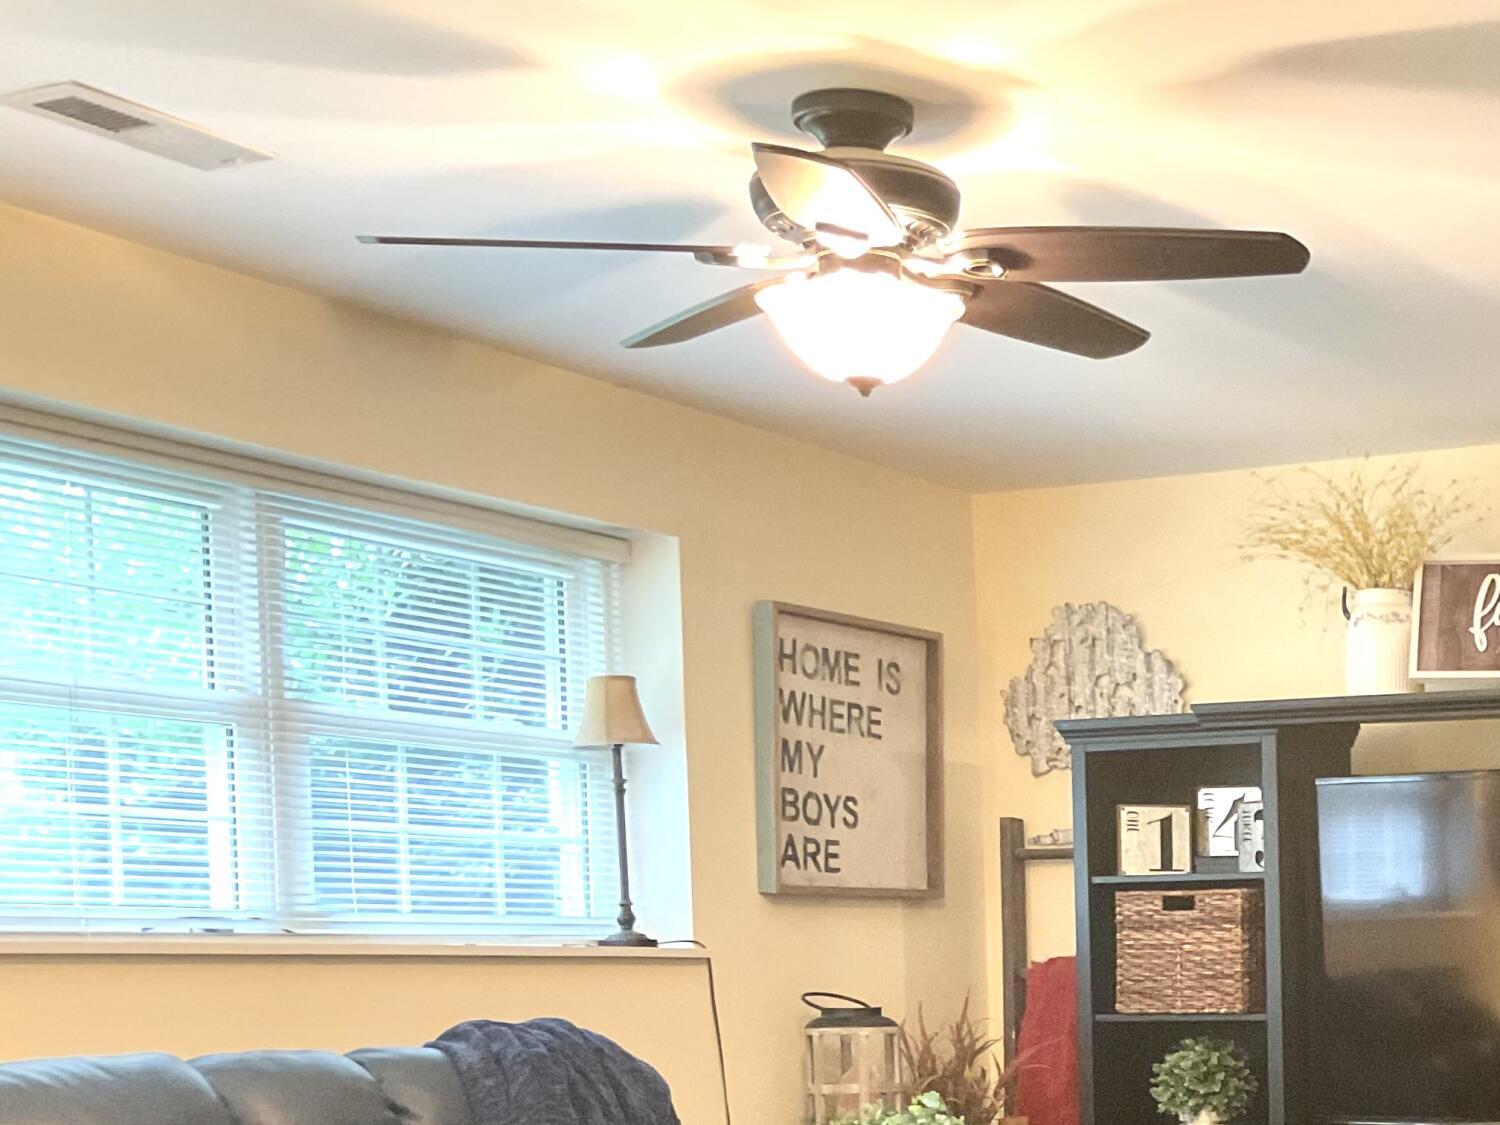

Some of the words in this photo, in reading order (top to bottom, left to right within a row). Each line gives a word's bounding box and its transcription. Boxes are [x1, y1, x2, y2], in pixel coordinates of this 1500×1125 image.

[778, 638, 861, 687] HOME
[877, 658, 901, 696] IS
[779, 687, 883, 740] WHERE
[781, 738, 825, 778] MY
[781, 787, 859, 829] BOYS
[781, 833, 841, 874] ARE
[1146, 813, 1185, 872] 1
